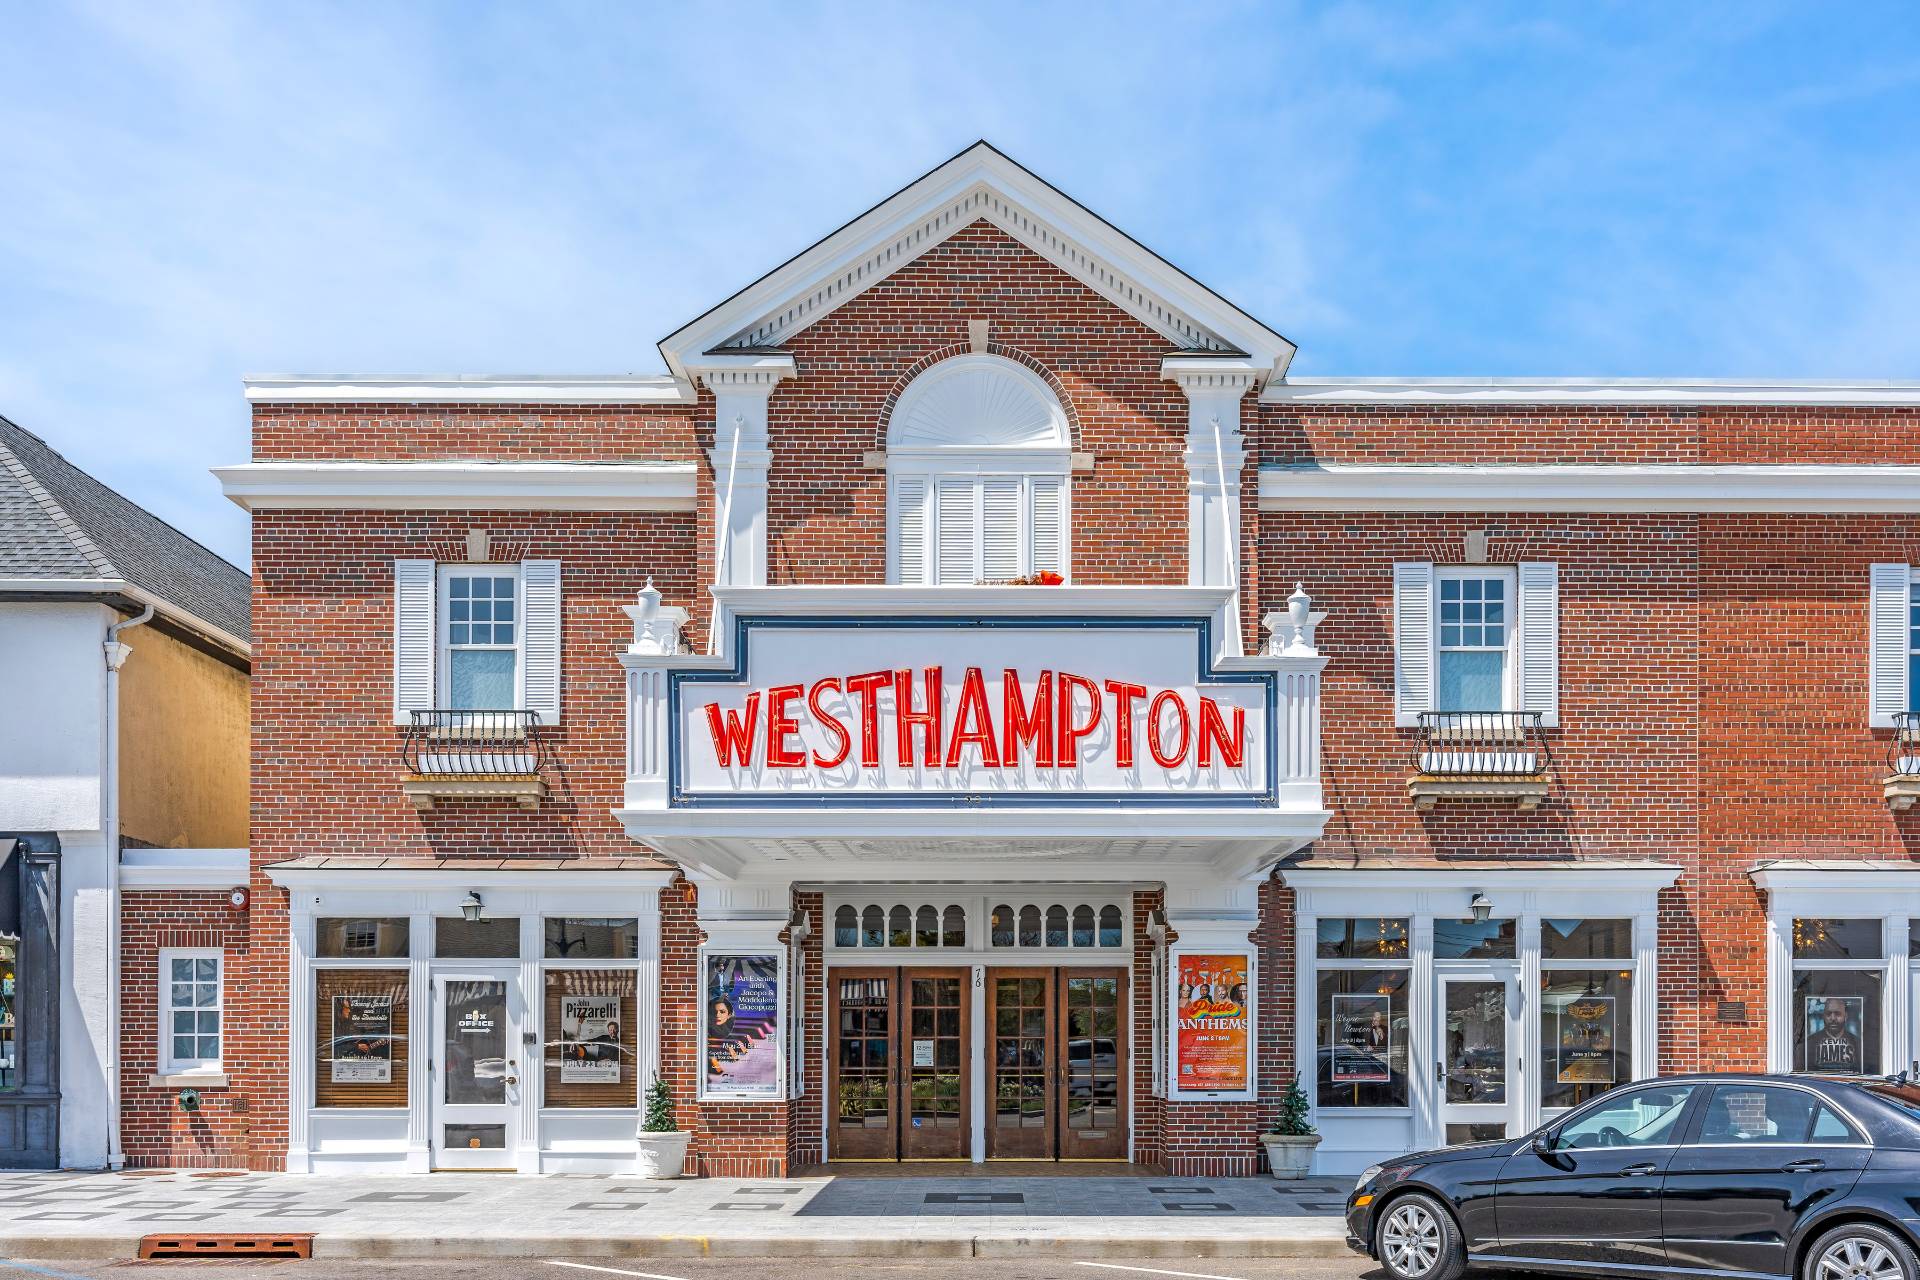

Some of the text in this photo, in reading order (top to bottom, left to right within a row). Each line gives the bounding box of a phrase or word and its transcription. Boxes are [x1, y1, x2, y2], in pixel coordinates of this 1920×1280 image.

[704, 665, 1245, 768] WESTHAMPTON
[566, 1002, 616, 1018] Pizzarelli
[577, 999, 590, 1007] John
[1188, 1000, 1235, 1015] Pride
[1177, 1018, 1248, 1030] ANTHEMS
[1815, 1044, 1855, 1063] JAMES
